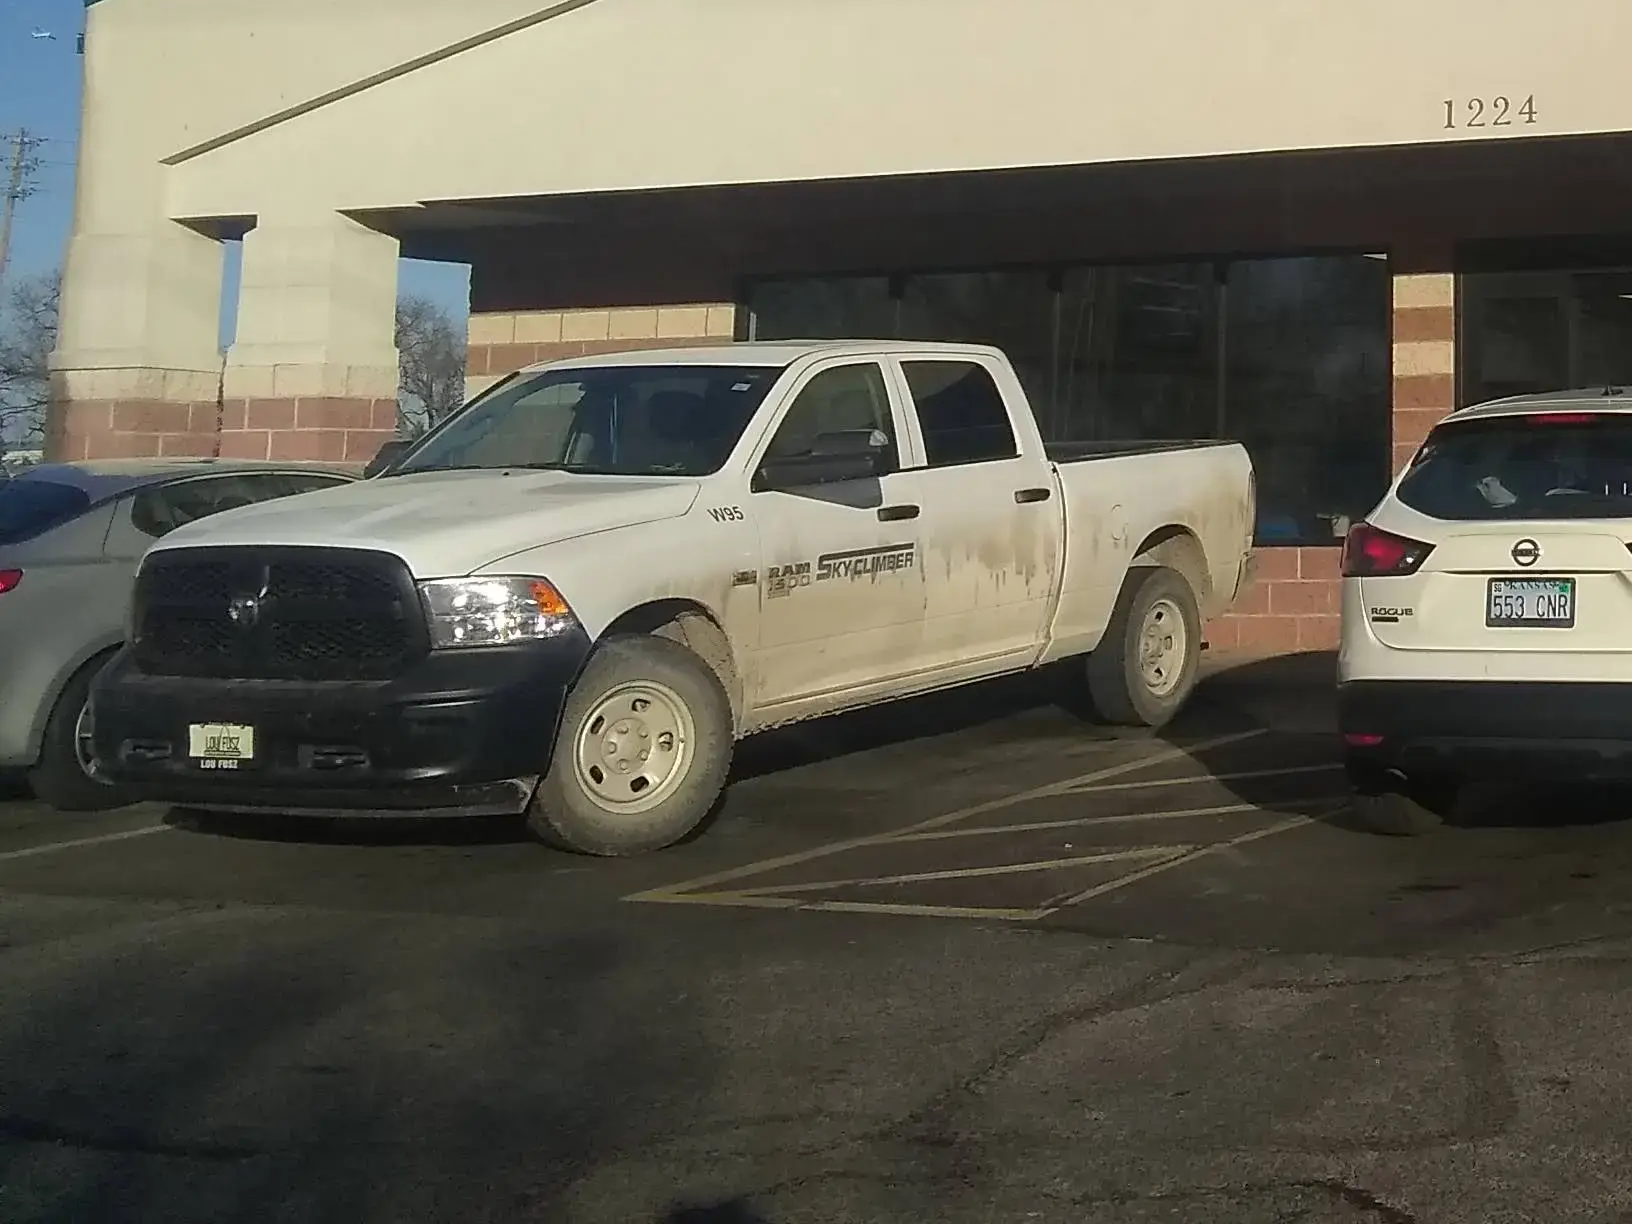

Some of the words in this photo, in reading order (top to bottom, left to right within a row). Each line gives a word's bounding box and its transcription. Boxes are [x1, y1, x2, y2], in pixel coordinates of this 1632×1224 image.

[1443, 94, 1538, 129] 1224
[706, 506, 744, 522] W95
[768, 562, 811, 579] RAM
[1371, 607, 1414, 616] ROGUE
[1493, 594, 1525, 619] 553
[1536, 594, 1568, 618] CNR
